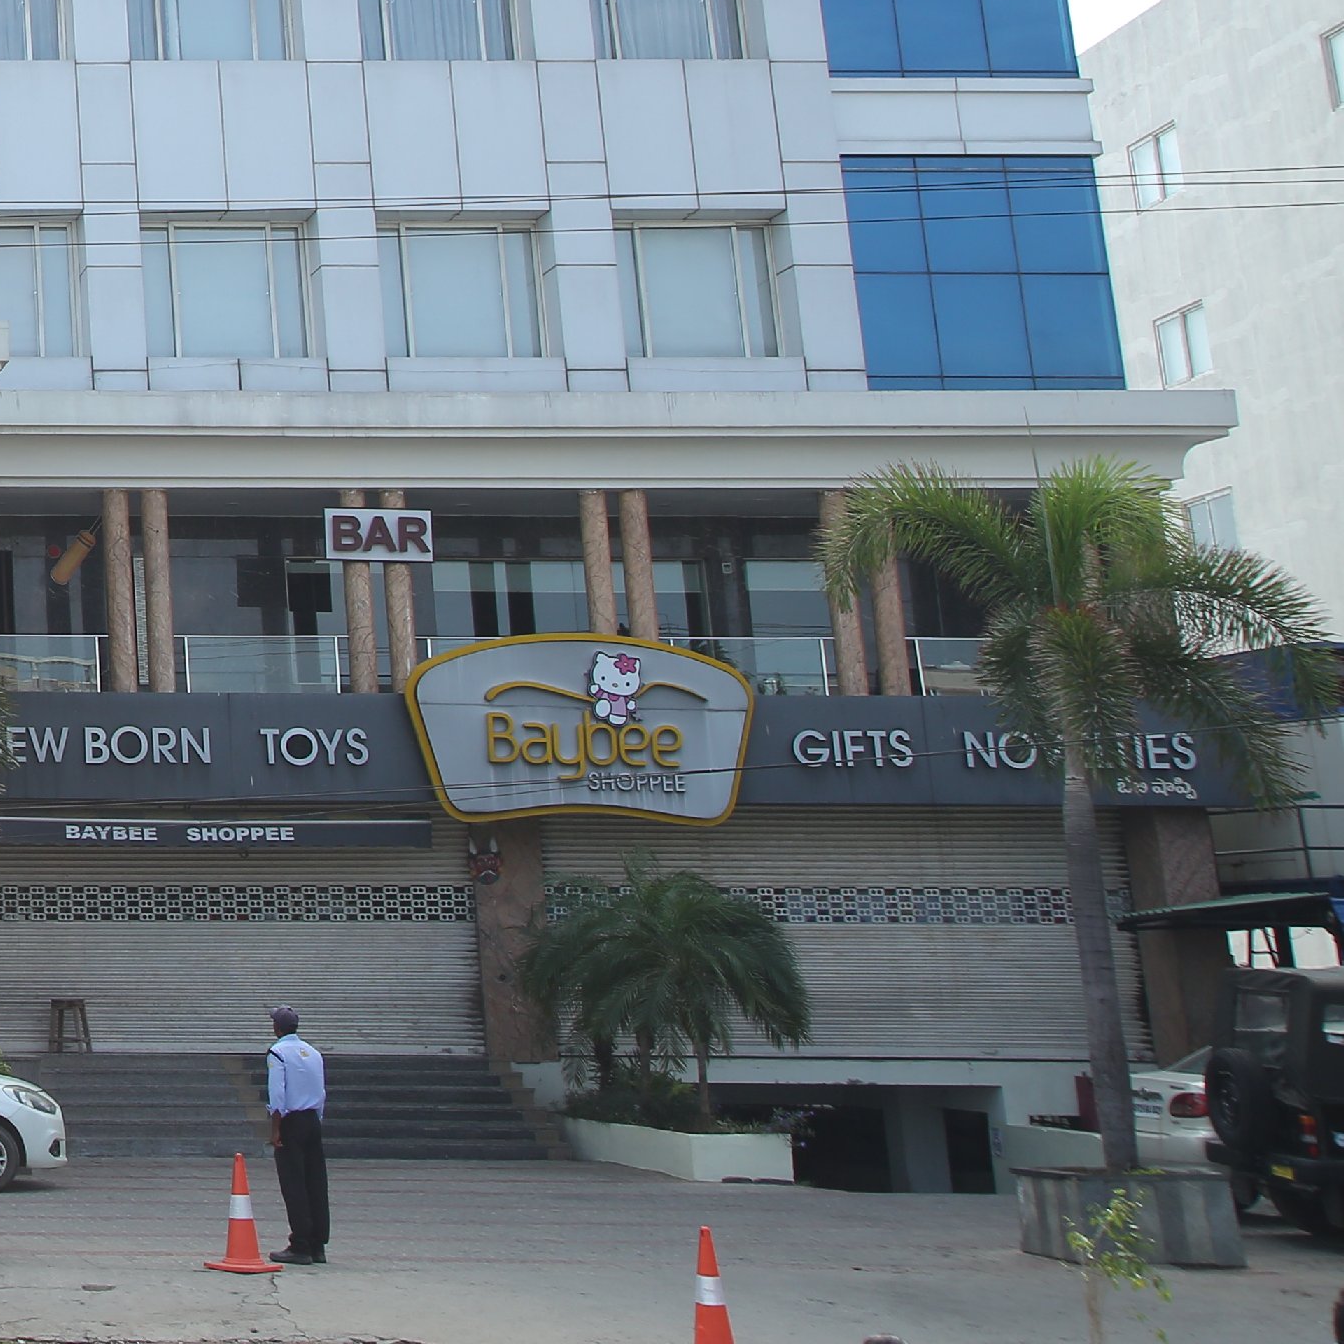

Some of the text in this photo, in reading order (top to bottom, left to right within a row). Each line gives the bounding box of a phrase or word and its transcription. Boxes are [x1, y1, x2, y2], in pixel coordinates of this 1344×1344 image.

[332, 515, 431, 553] BAR
[84, 725, 212, 765] BORN
[259, 727, 370, 766] TOYS
[485, 709, 683, 779] Baybee
[792, 729, 915, 769] GIFTS
[587, 771, 687, 793] SHOPPEE
[65, 824, 295, 842] BAYBEE SHOPPEE
